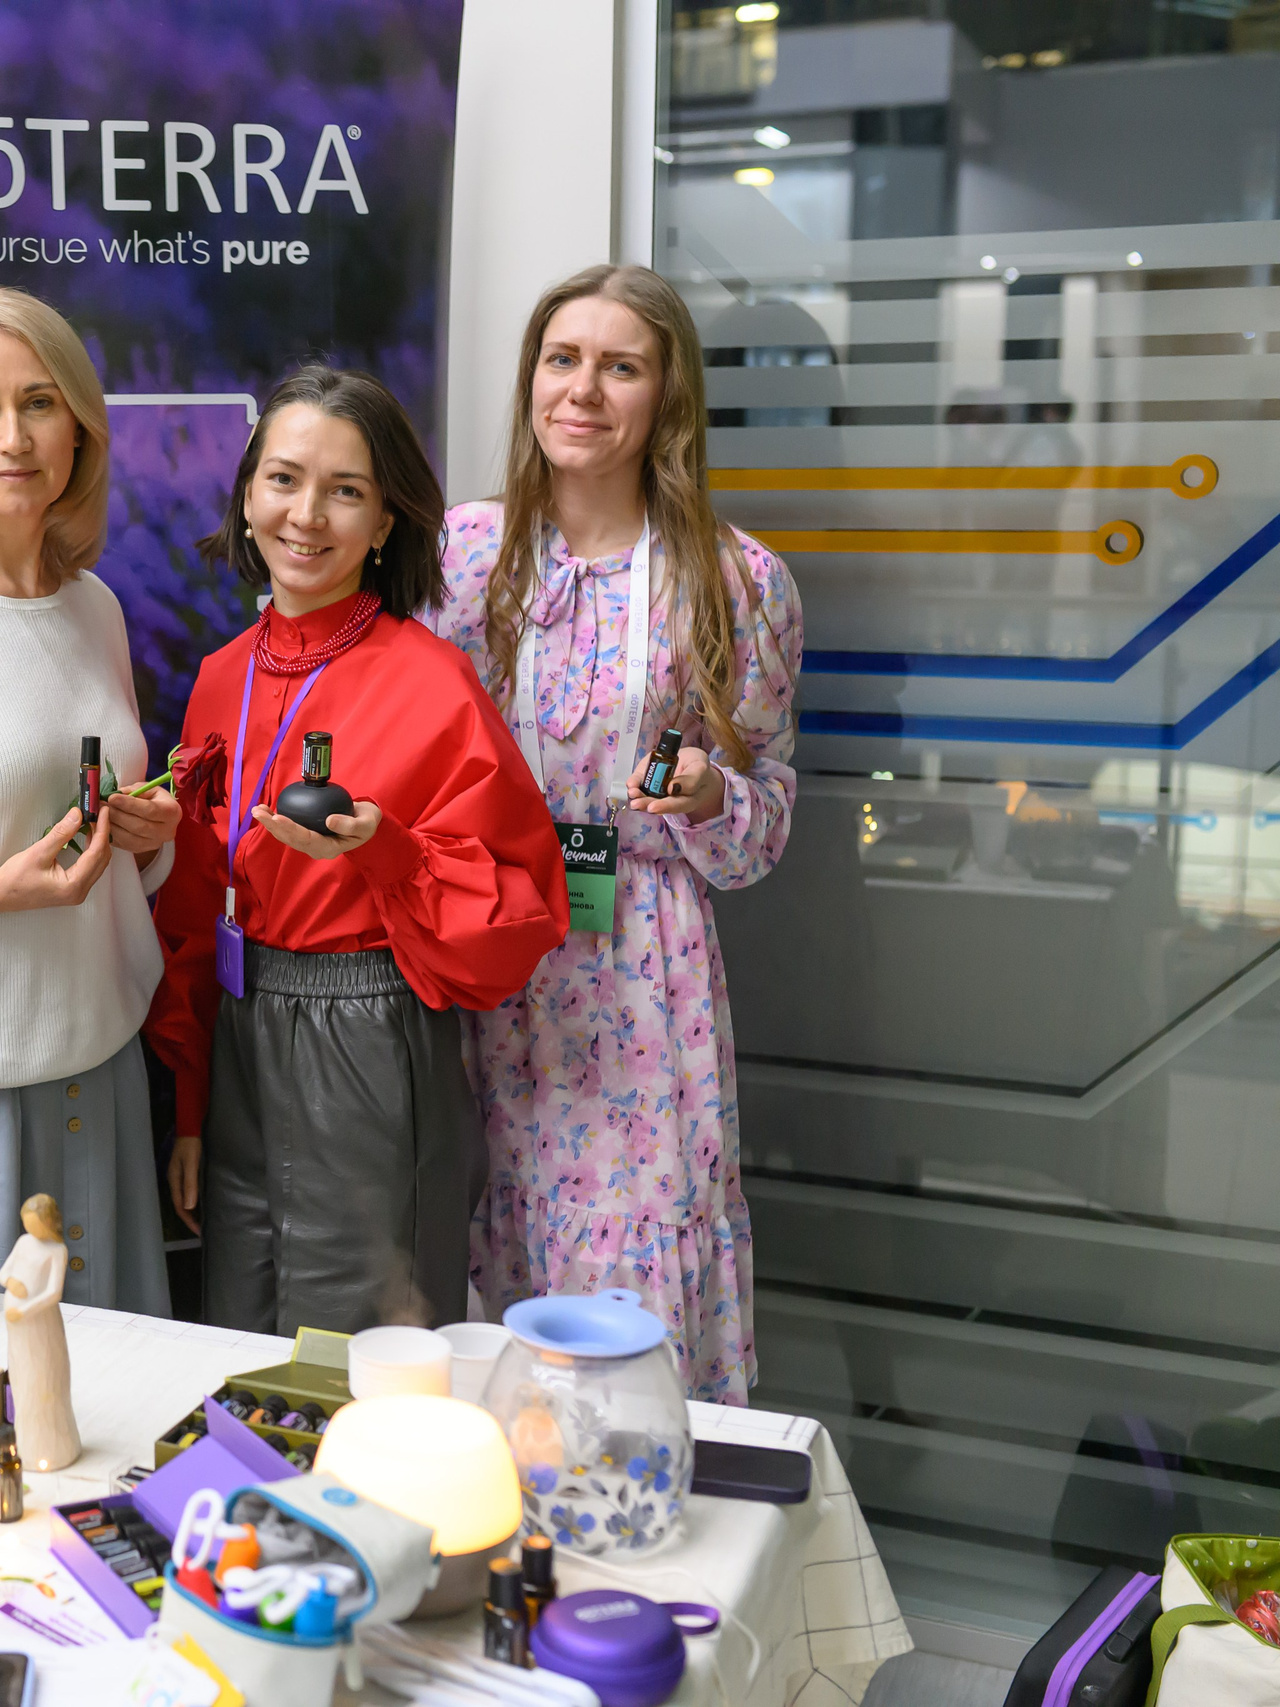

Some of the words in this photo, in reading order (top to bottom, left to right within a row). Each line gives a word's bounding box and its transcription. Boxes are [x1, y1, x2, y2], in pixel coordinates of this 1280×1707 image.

[99, 230, 210, 265] what's
[222, 239, 310, 273] pure
[626, 693, 640, 735] dōTERRA
[644, 762, 657, 789] dōTERRA
